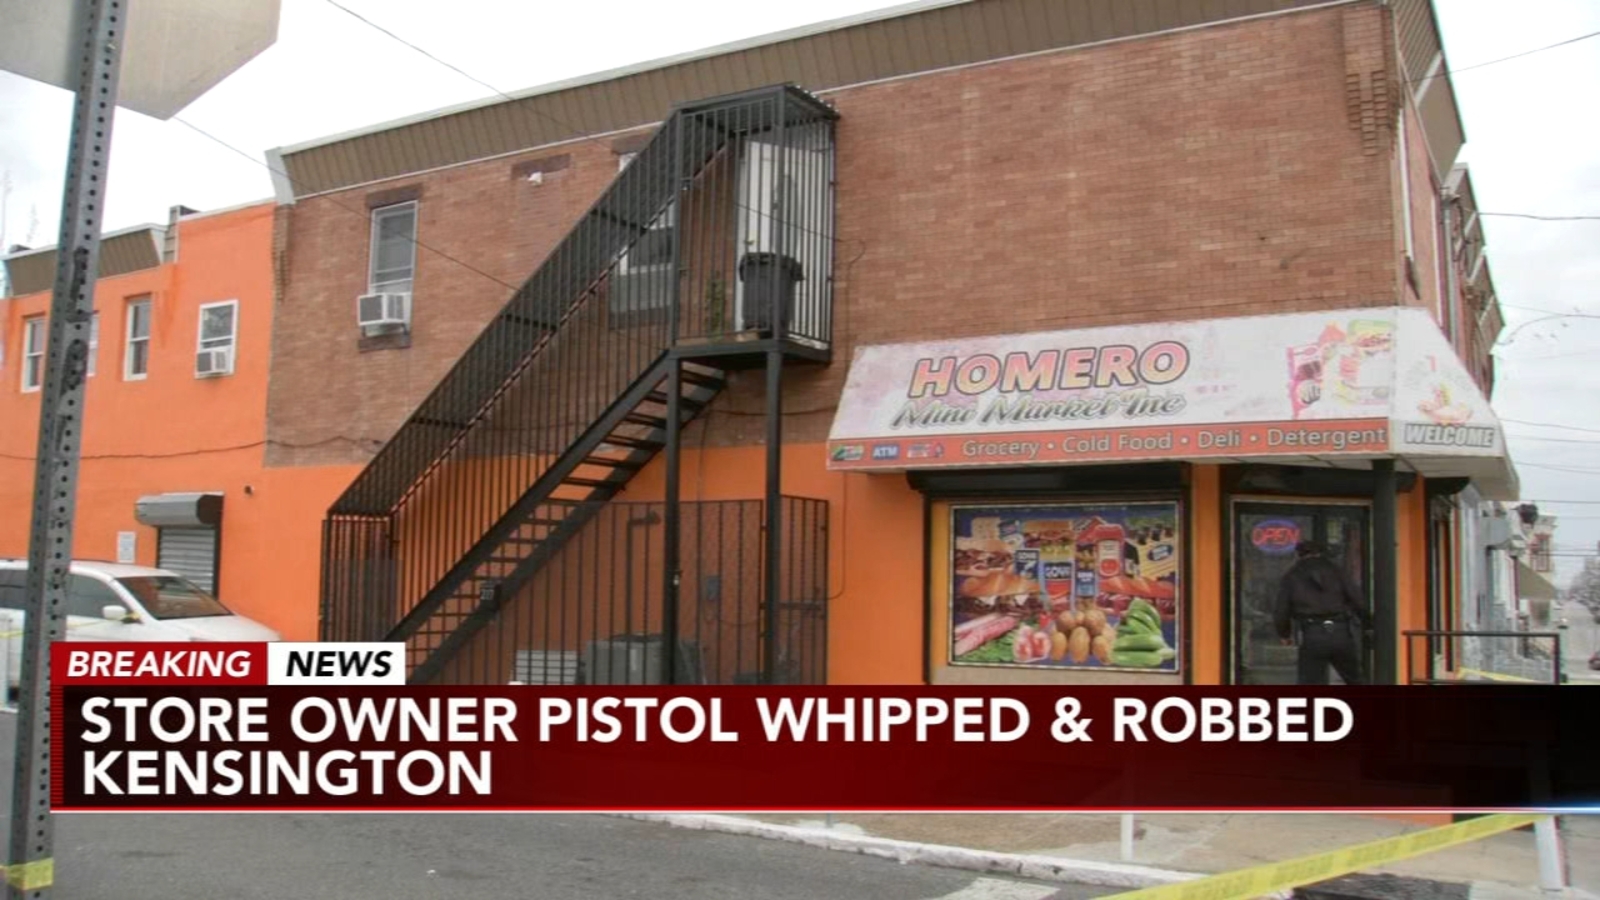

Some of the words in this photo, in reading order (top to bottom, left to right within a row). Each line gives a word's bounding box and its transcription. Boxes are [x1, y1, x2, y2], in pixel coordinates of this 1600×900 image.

[908, 341, 1190, 398] HOMERO
[1119, 391, 1188, 416] Inc
[962, 440, 1040, 458] Grocery
[1062, 435, 1111, 453] Cold
[1118, 432, 1173, 450] Food
[1197, 430, 1241, 448] Deli
[1267, 427, 1386, 448] Detergent
[1404, 424, 1494, 447] WELCOME
[872, 445, 899, 458] ATM
[1251, 526, 1301, 546] OPEN
